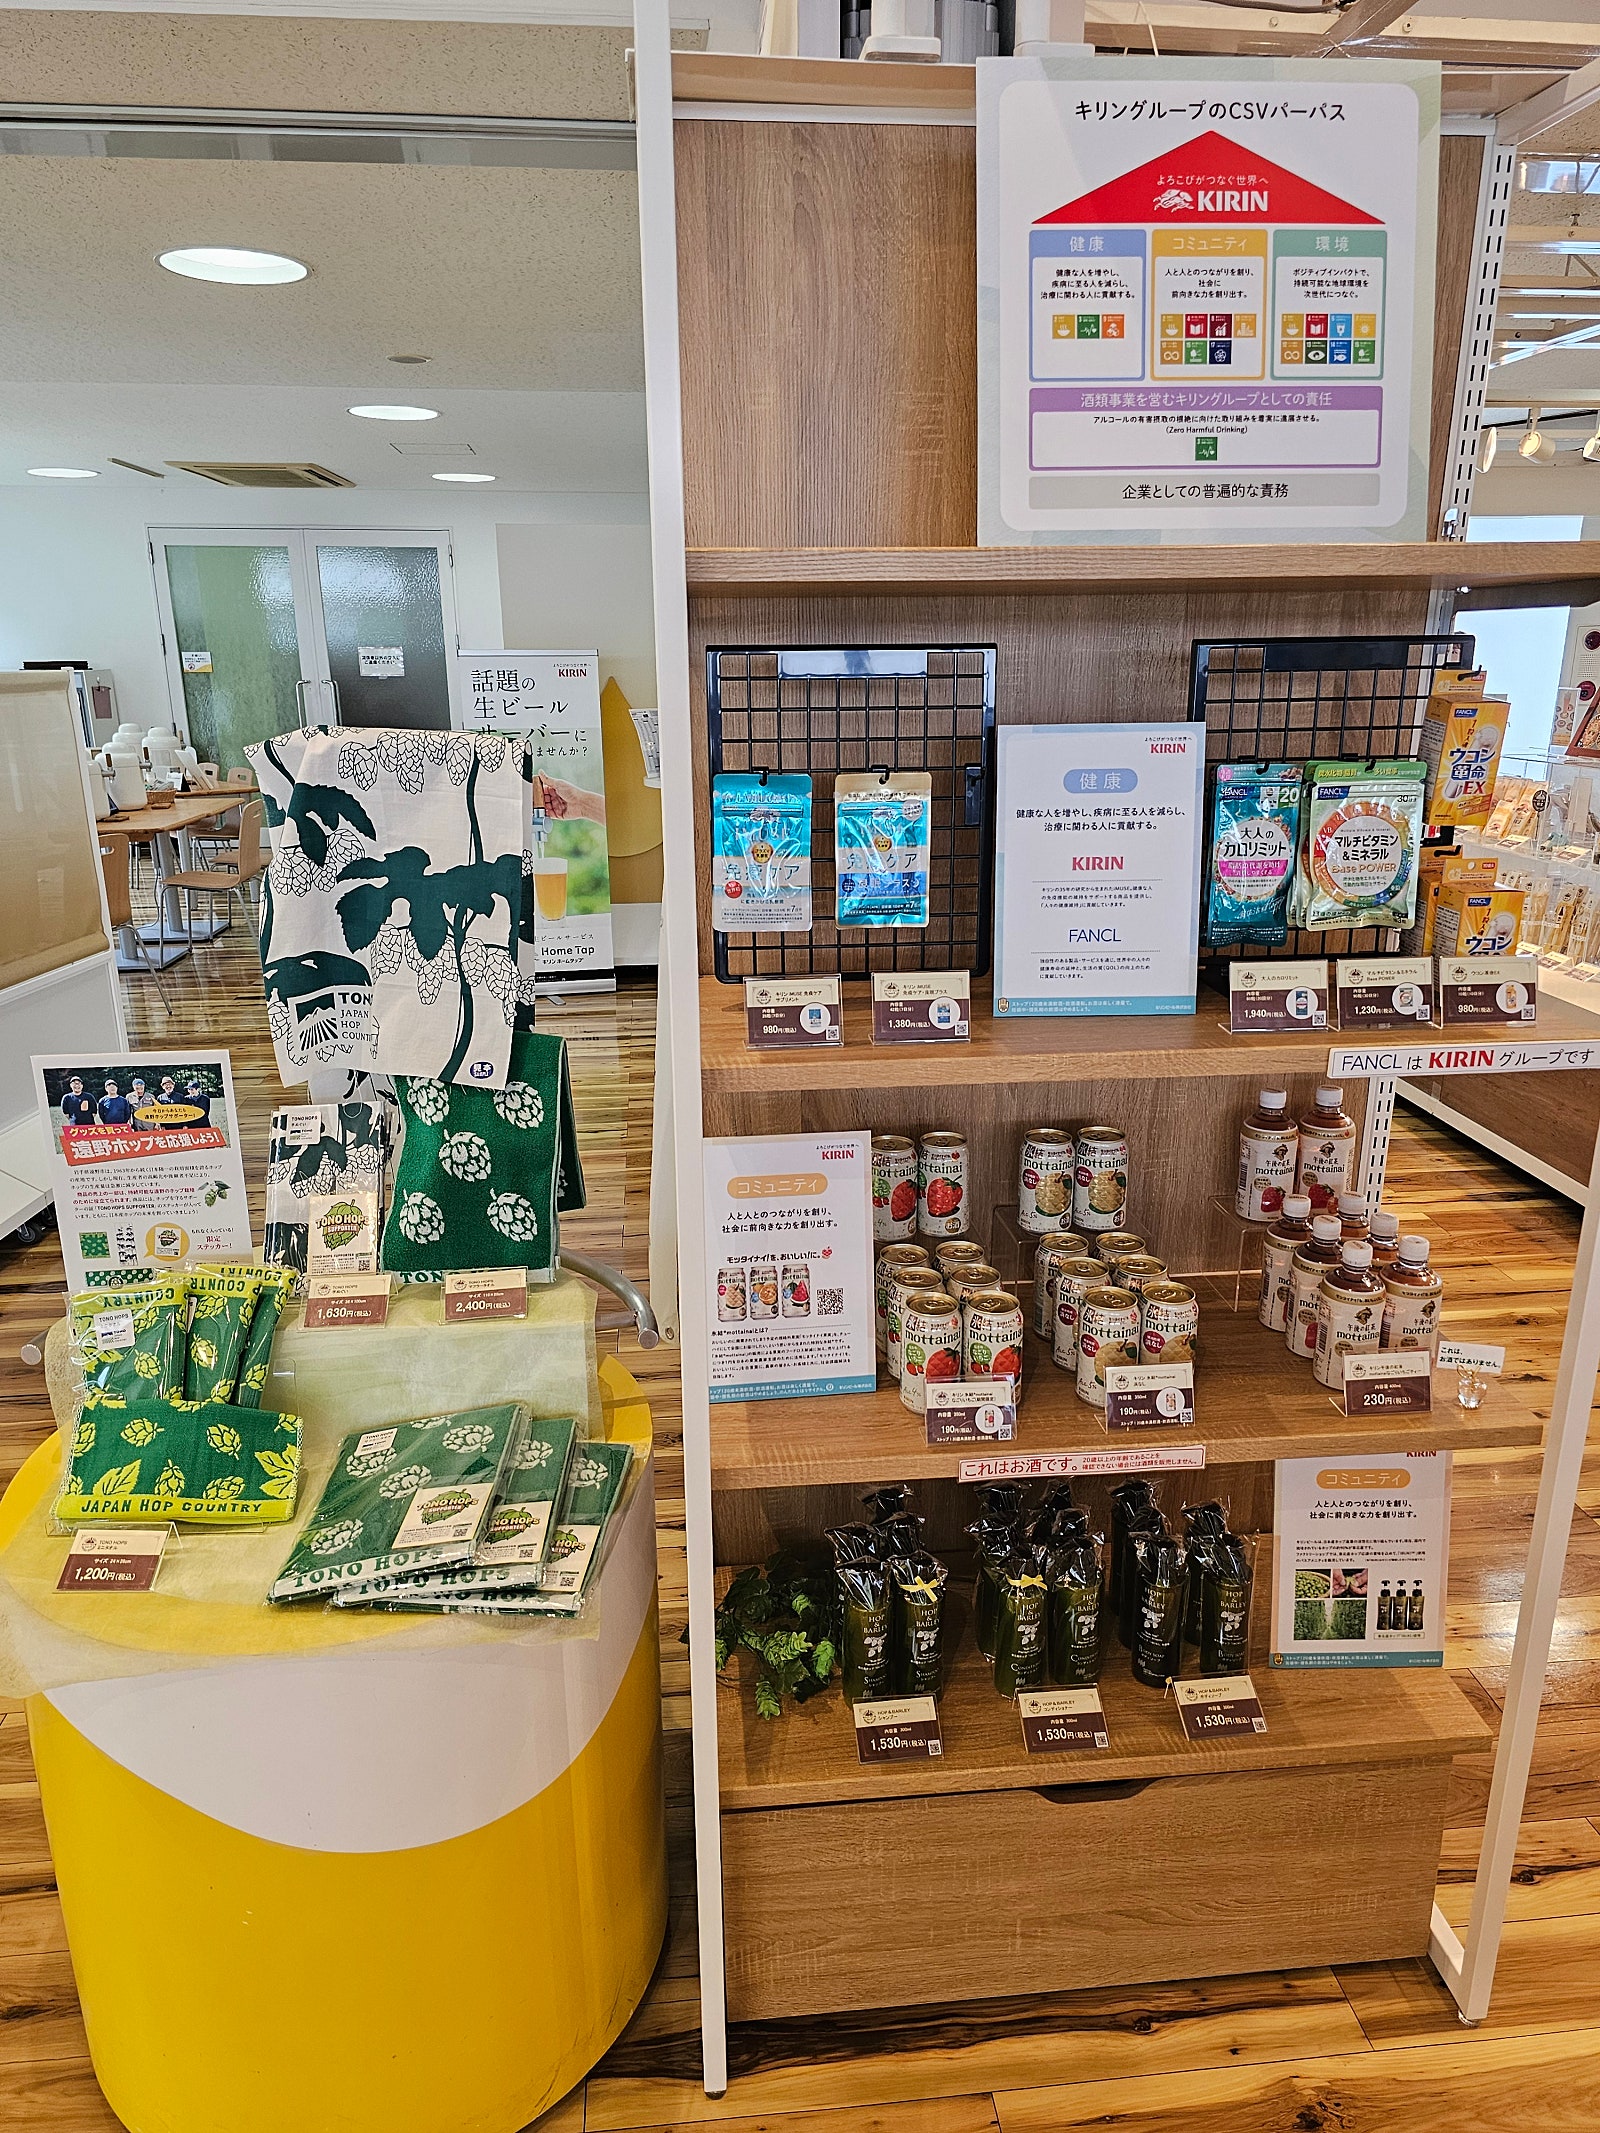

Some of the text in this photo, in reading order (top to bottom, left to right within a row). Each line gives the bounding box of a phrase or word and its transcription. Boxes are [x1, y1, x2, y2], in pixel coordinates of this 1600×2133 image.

[1074, 101, 1346, 122] キリングループのCSVパーパス
[1156, 175, 1269, 187] よろこびがつなぐ世界へ
[1198, 191, 1268, 212] KIRIN
[1069, 236, 1105, 252] 健康
[1172, 237, 1248, 252] コミュニティ
[1315, 236, 1349, 252] 環境
[1056, 269, 1121, 278] 健康な人を増やし、
[1165, 268, 1255, 278] 人と人とのつながりを創り、
[1293, 268, 1370, 278] ポジティブインパクトで、
[1051, 279, 1128, 289] 疾病に至る人を減らし、
[1198, 279, 1221, 289] 社会に
[1293, 279, 1369, 289] 持続可能な地球環境を
[1040, 291, 1136, 300] 治療に関わる人に貢献する。
[1171, 291, 1249, 301] 前向きな力を創り出す。
[1304, 291, 1359, 300] 次世代につなぐ。
[1081, 391, 1332, 408] 酒類事業を営むキリングループとしての責任
[1166, 426, 1184, 435] (Zero
[1217, 425, 1248, 435] Drinking)
[1122, 484, 1289, 499] 企業としての普遍的な責務
[559, 668, 587, 677] KIRIN
[471, 669, 535, 693] 話題の
[473, 696, 568, 719] 生ビール
[1151, 744, 1185, 753] KIRIN
[1450, 749, 1495, 765] ウコン
[1451, 765, 1485, 780] 革命
[1080, 773, 1121, 789] 健康
[1463, 781, 1486, 794] EX
[1280, 788, 1299, 802] 20
[1016, 807, 1185, 818] 健康な人を増やし、疾病に至る人を減らし、
[1044, 821, 1157, 832] 治療に関わる人に貢献する。
[1241, 827, 1273, 839] 大人の
[1335, 835, 1398, 847] マルチビタミン
[1224, 841, 1286, 857] カロリミット
[1342, 849, 1389, 861] &ミネラル
[1072, 856, 1124, 870] KIRIN
[1332, 863, 1396, 874] Base POWER
[1069, 929, 1121, 942] FANCL
[1466, 936, 1512, 953] ウコン
[541, 946, 594, 956] Home Tap
[340, 1009, 369, 1019] JAPAN
[1244, 1009, 1286, 1018] 1,940円(税込)
[1355, 1006, 1396, 1014] 1,230円(税込)
[1458, 1004, 1493, 1013] 980円(税込)
[341, 1020, 360, 1029] HOP
[763, 1025, 797, 1034] 980円(税込)
[889, 1020, 930, 1029] 1,380円(税込)
[1342, 1048, 1595, 1071] FANCL は KIRIN グループです
[473, 1063, 491, 1072] 見本
[70, 1126, 129, 1137] グッズを買って
[70, 1131, 220, 1159] 遠野ホップを応援しよう!
[1078, 1142, 1097, 1157] 氷結
[822, 1150, 854, 1160] KIRIN
[1025, 1145, 1043, 1159] 氷結
[1256, 1164, 1295, 1176] mottainai
[1304, 1163, 1345, 1173] mottainai
[738, 1179, 817, 1193] コミュニティ
[728, 1208, 832, 1221] 人と人とのつながりを創り、
[316, 1214, 369, 1229] TONO HOPS
[722, 1221, 838, 1233] 社会に前向きな力を創り出す。
[327, 1225, 357, 1234] SUPPORTER
[456, 1300, 511, 1312] 2,400円(税込)
[1146, 1304, 1170, 1320] 氷結
[317, 1306, 372, 1320] 1,630円(税込)
[1084, 1307, 1104, 1325] 氷結
[906, 1314, 926, 1332] 氷結
[970, 1314, 992, 1331] 氷結
[1348, 1323, 1376, 1332] 午後の紅茶
[1082, 1322, 1139, 1339] mottainai
[1441, 1347, 1463, 1355] これは、
[1440, 1356, 1501, 1368] お酒ではありません。
[1364, 1394, 1411, 1406] 230円(税込)
[1120, 1407, 1151, 1415] 190円(税込)
[1082, 1458, 1198, 1470] 確認できない場合には酒類を販売しません。
[1083, 1453, 1160, 1463] 20歳以上の年齢であることを
[964, 1457, 1078, 1477] これはお酒です。
[1326, 1473, 1401, 1486] コミュニティ
[81, 1499, 262, 1513] JAPAN HOP COUNTRY
[416, 1497, 479, 1510] TONO HOPS
[1315, 1500, 1413, 1508] 人と人とのつながりを創り、
[513, 1517, 540, 1525] HOPS
[1310, 1511, 1418, 1519] 社会に前向きな力を創り出す。
[560, 1539, 586, 1551] HOPS
[293, 1546, 443, 1587] TONO HOPS
[75, 1567, 136, 1581] 1,200円(税込)
[440, 1567, 511, 1585] HOPS
[1195, 1713, 1251, 1728] 1,530円(税込)
[1037, 1728, 1093, 1741] 1,530円(税込)
[871, 1737, 927, 1751] 1,530円(税込)
